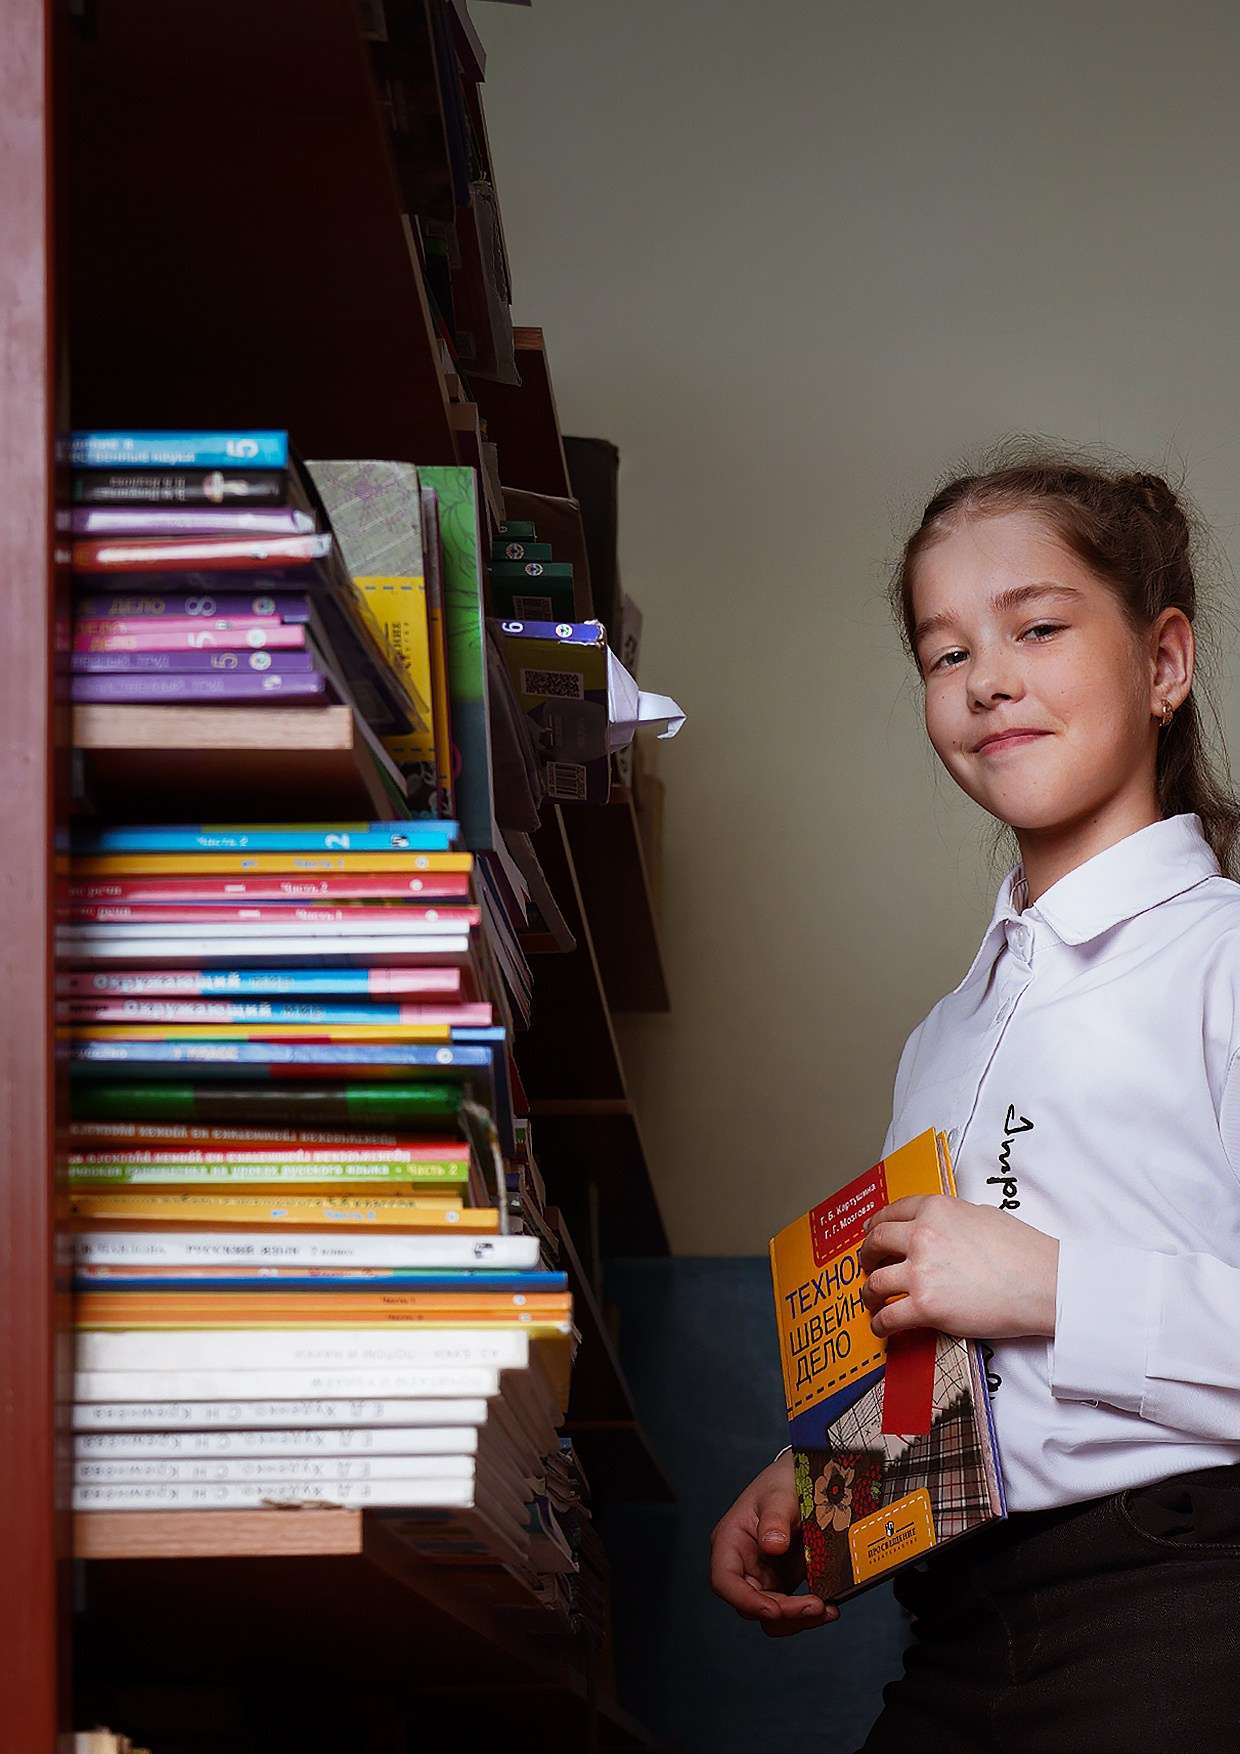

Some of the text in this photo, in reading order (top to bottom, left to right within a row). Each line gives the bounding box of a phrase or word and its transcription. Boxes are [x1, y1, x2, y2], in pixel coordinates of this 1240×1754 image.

[92, 972, 241, 991] Окружающий
[123, 1001, 273, 1019] Окружающий
[836, 1182, 876, 1215] Картушина
[789, 1291, 865, 1357] ШВЕЙН
[795, 1329, 852, 1392] ДЕЛО
[868, 1528, 916, 1558] ПРОСВЕЩЕНИЕ
